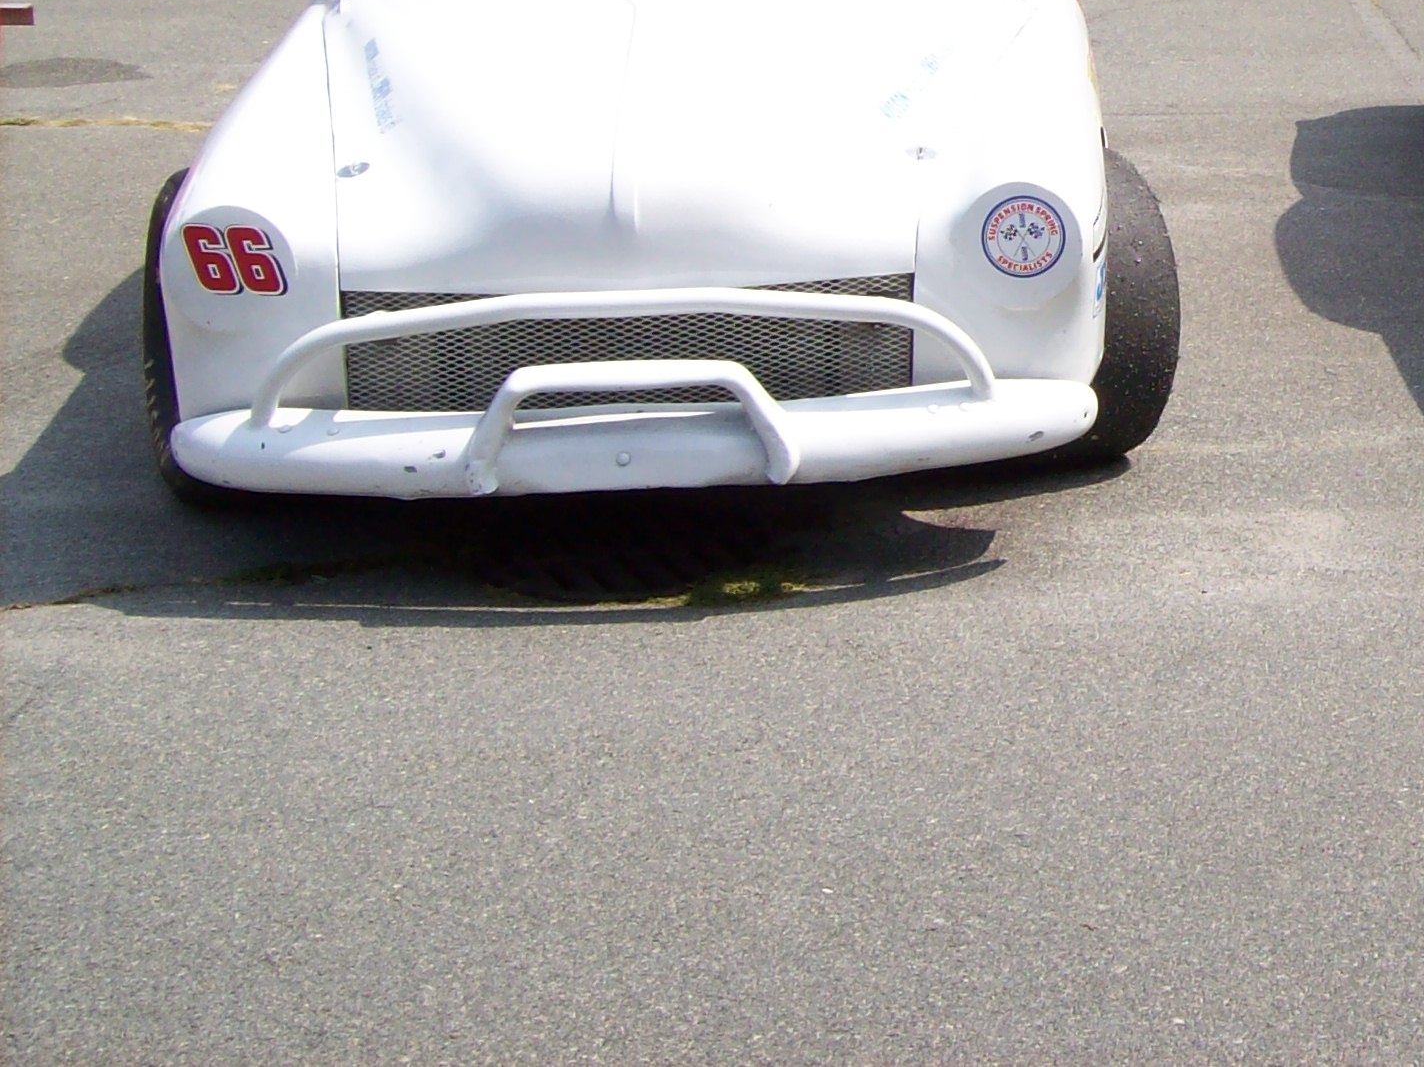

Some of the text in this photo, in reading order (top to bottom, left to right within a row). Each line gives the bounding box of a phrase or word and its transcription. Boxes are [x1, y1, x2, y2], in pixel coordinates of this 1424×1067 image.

[988, 201, 1059, 241] SUSPENSION SPRING
[181, 223, 288, 296] 66
[997, 251, 1054, 272] SPECIALISTS
